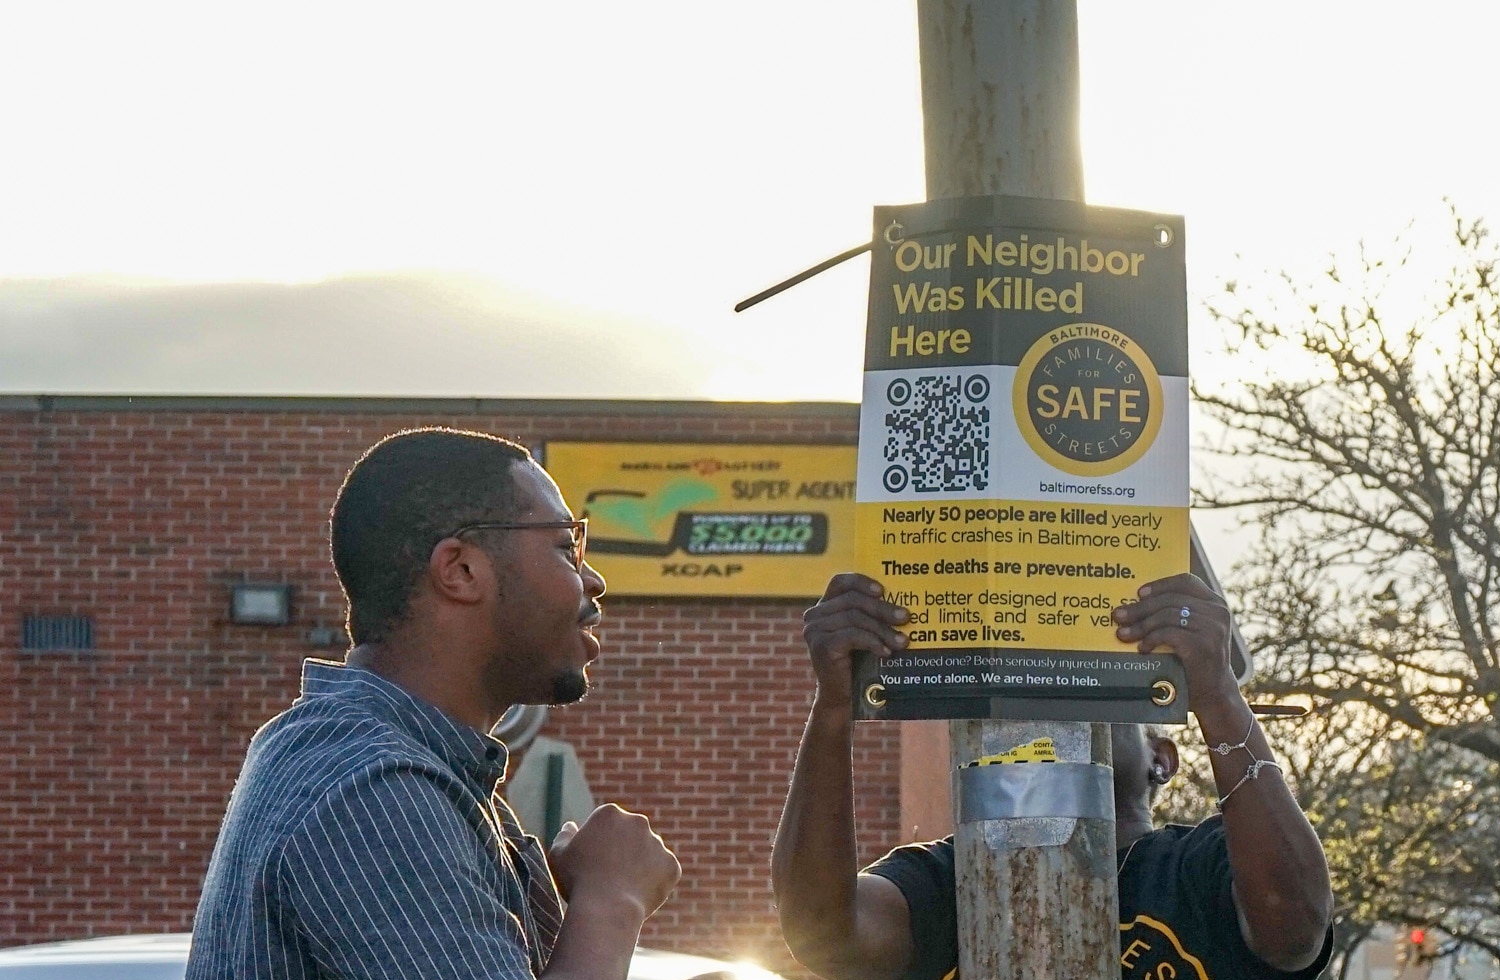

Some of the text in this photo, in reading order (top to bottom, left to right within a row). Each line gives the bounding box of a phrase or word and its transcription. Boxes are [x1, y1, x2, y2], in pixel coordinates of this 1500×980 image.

[895, 234, 1145, 277] Our Neighbor
[892, 276, 1083, 315] Was Killed
[889, 325, 972, 357] Here
[1049, 326, 1129, 349] BALTIMORE
[1043, 346, 1136, 384] FAMILIES
[1078, 369, 1100, 378] FOR
[1036, 384, 1141, 423] SAFE
[1044, 423, 1132, 455] STREETS
[731, 479, 790, 500] SUPER
[1040, 481, 1135, 498] baltimorefss.org
[883, 506, 1162, 530] Nearly 50 people are killed yearly
[882, 527, 1161, 551] in traffic crashes in Baltimore City.
[881, 559, 1136, 579] These deaths are preventable.
[882, 590, 919, 606] With
[925, 591, 973, 606] better
[978, 589, 1056, 608] designed
[1063, 593, 1114, 610] roads,
[939, 608, 984, 625] limits,
[994, 609, 1027, 623] and
[1038, 610, 1080, 625] safer
[909, 626, 1025, 641] can save lives.
[880, 655, 1161, 671] Lost a loved one? Been seriously injured in a crash?
[880, 672, 1101, 687] You are not alone. We are here to help.
